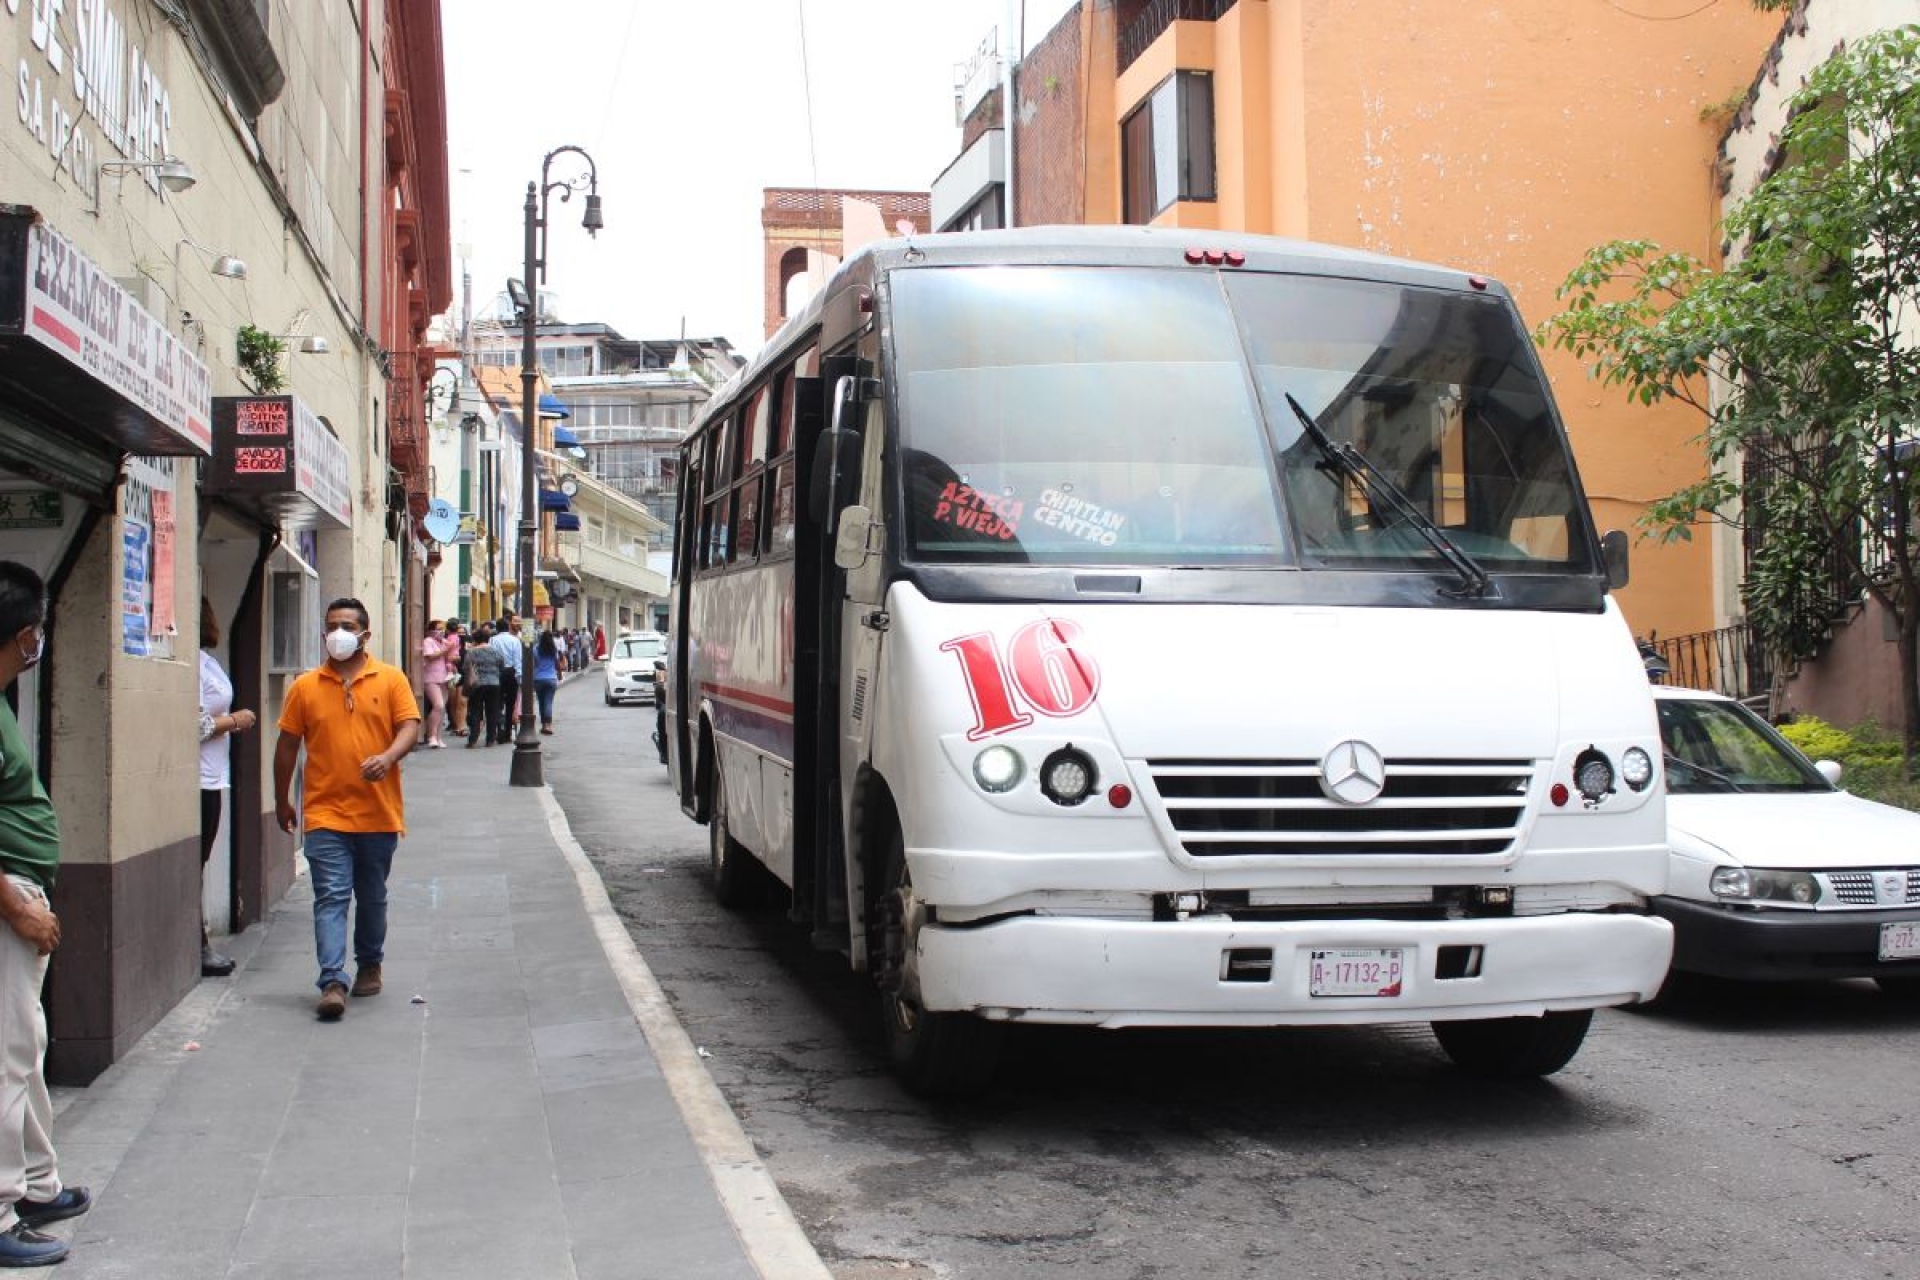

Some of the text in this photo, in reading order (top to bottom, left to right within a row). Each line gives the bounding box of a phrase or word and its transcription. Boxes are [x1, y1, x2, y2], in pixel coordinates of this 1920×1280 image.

[35, 224, 212, 418] EXAMEN DE LA VISTA
[239, 420, 284, 433] GRATIS
[933, 502, 1018, 540] P. VIEJO
[940, 482, 1024, 521] AZTECA
[1039, 488, 1126, 529] CHIPITLAN
[1033, 506, 1118, 546] CENTRO
[939, 618, 1101, 742] 16
[1312, 962, 1400, 985] A-17132-P
